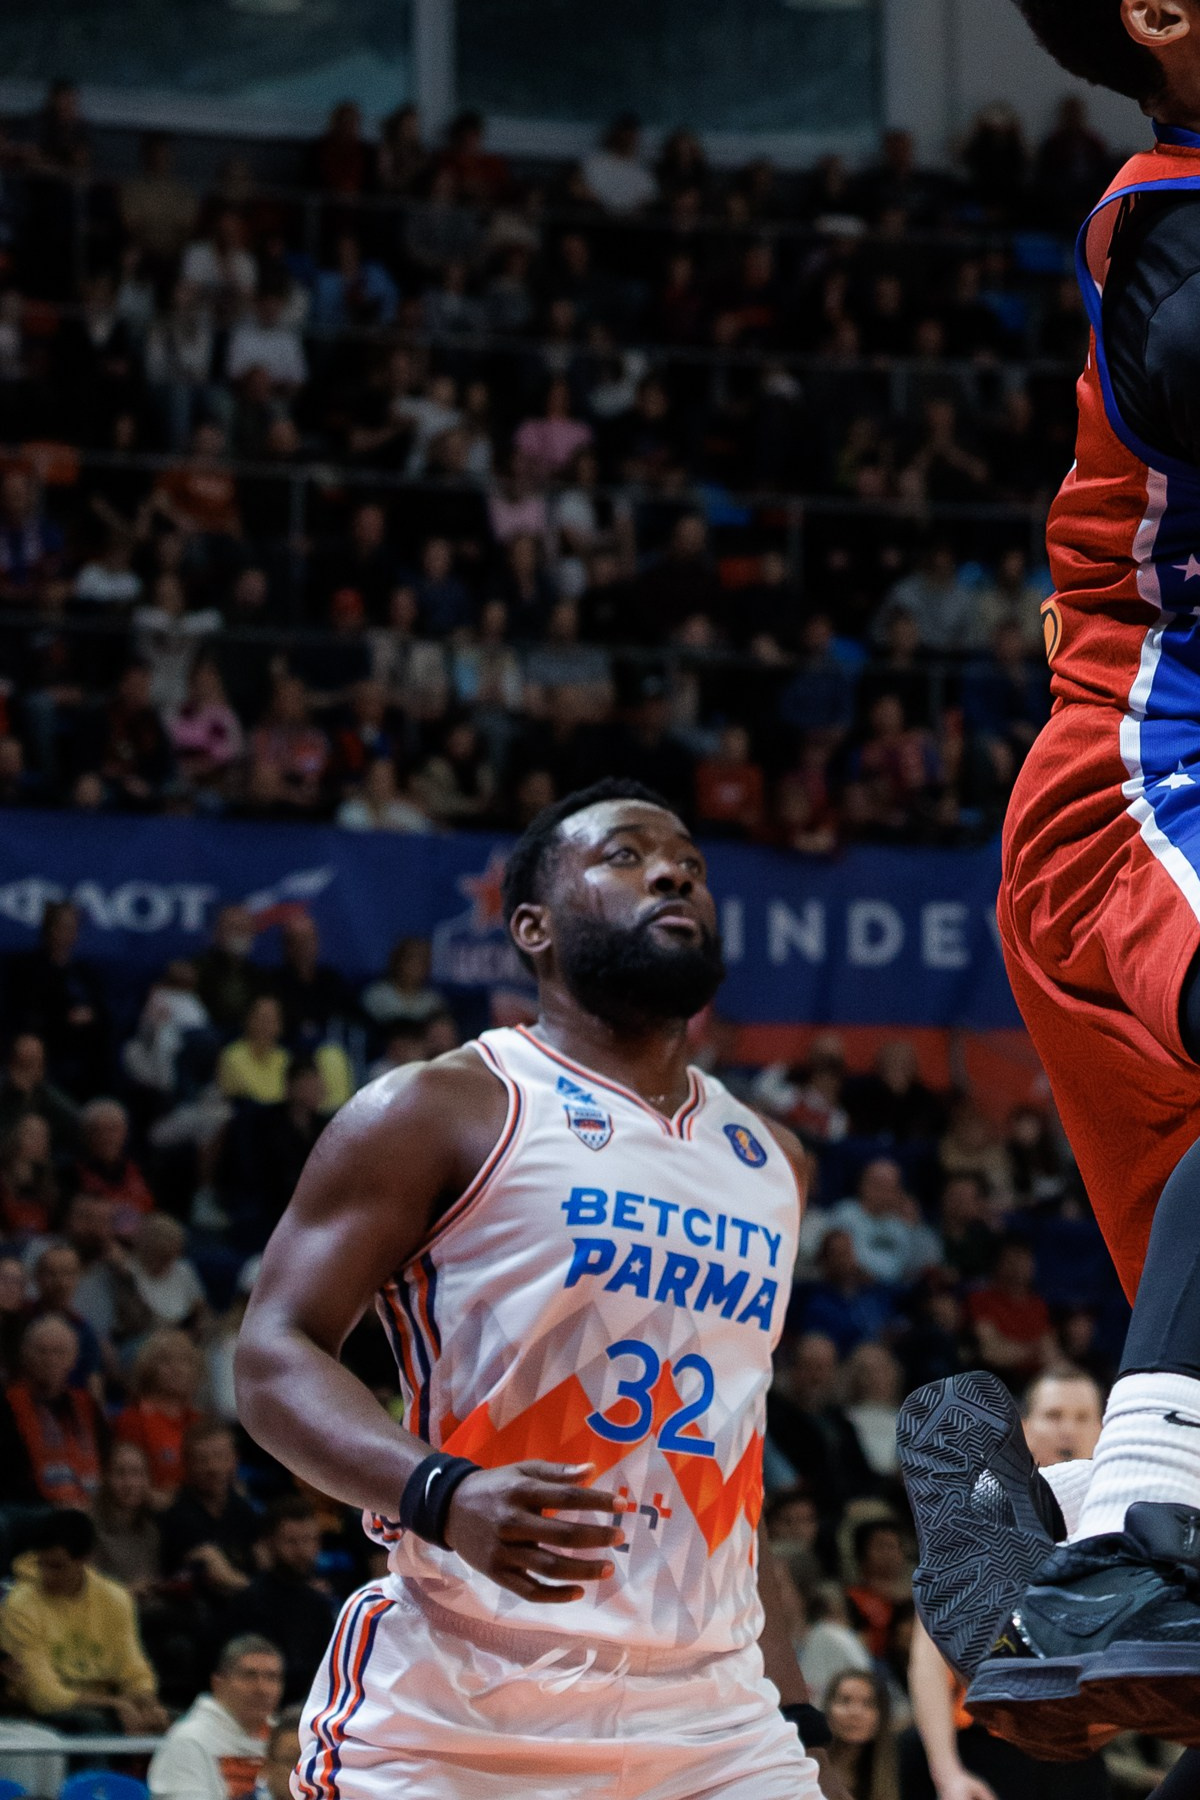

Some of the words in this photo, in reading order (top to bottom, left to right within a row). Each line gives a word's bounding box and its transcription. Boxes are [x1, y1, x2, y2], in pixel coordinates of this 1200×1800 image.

[721, 897, 1002, 967] INDE
[561, 1187, 781, 1267] BETCITY
[564, 1238, 779, 1331] PARMA
[586, 1340, 716, 1457] 32
